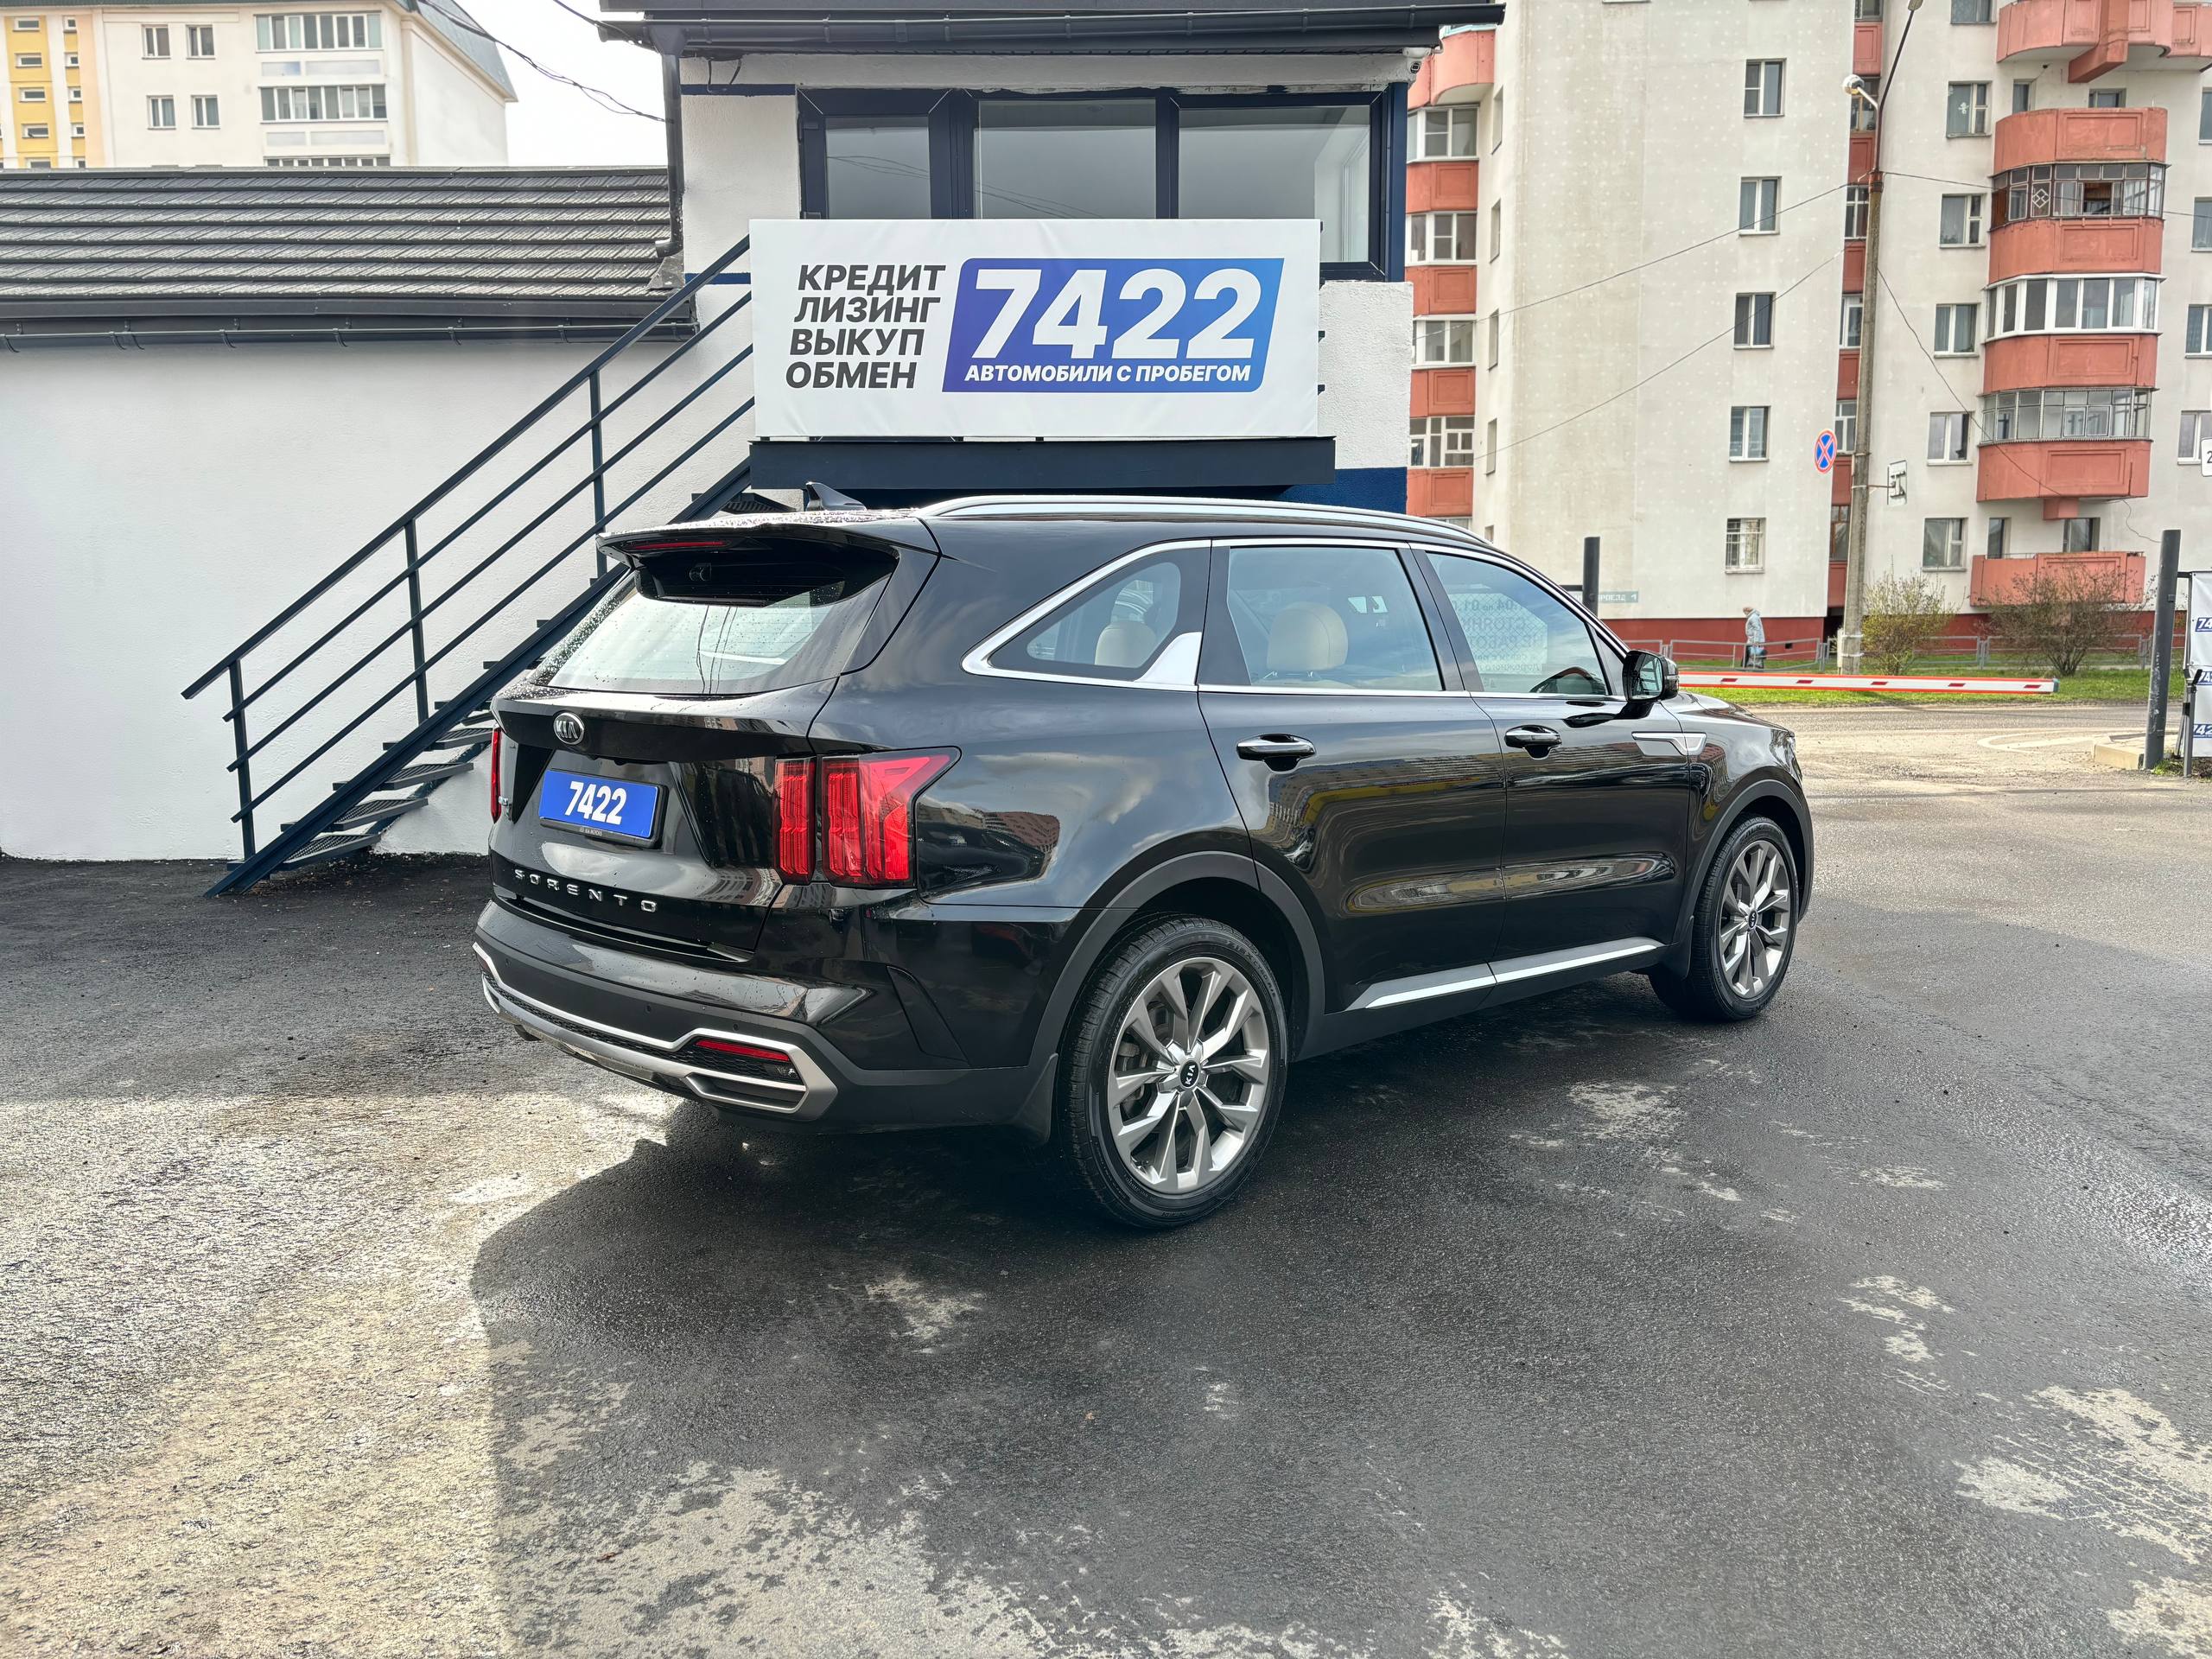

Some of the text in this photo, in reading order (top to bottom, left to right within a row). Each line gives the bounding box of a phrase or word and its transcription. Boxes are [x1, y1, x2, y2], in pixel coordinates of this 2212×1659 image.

[798, 264, 946, 292] КРЕДИТ
[793, 296, 941, 323] ЛИЗИНГ
[971, 268, 1262, 359] 7422
[789, 328, 925, 356] ВЫКУП
[785, 361, 918, 389] ОБМЕН
[964, 365, 1251, 382] АВТОМОБИЛИ С ПРОБЕГОМ
[556, 720, 579, 740] KIA
[564, 780, 627, 825] 7422
[513, 868, 658, 913] SORENTO
[1185, 1065, 1196, 1085] KIA
